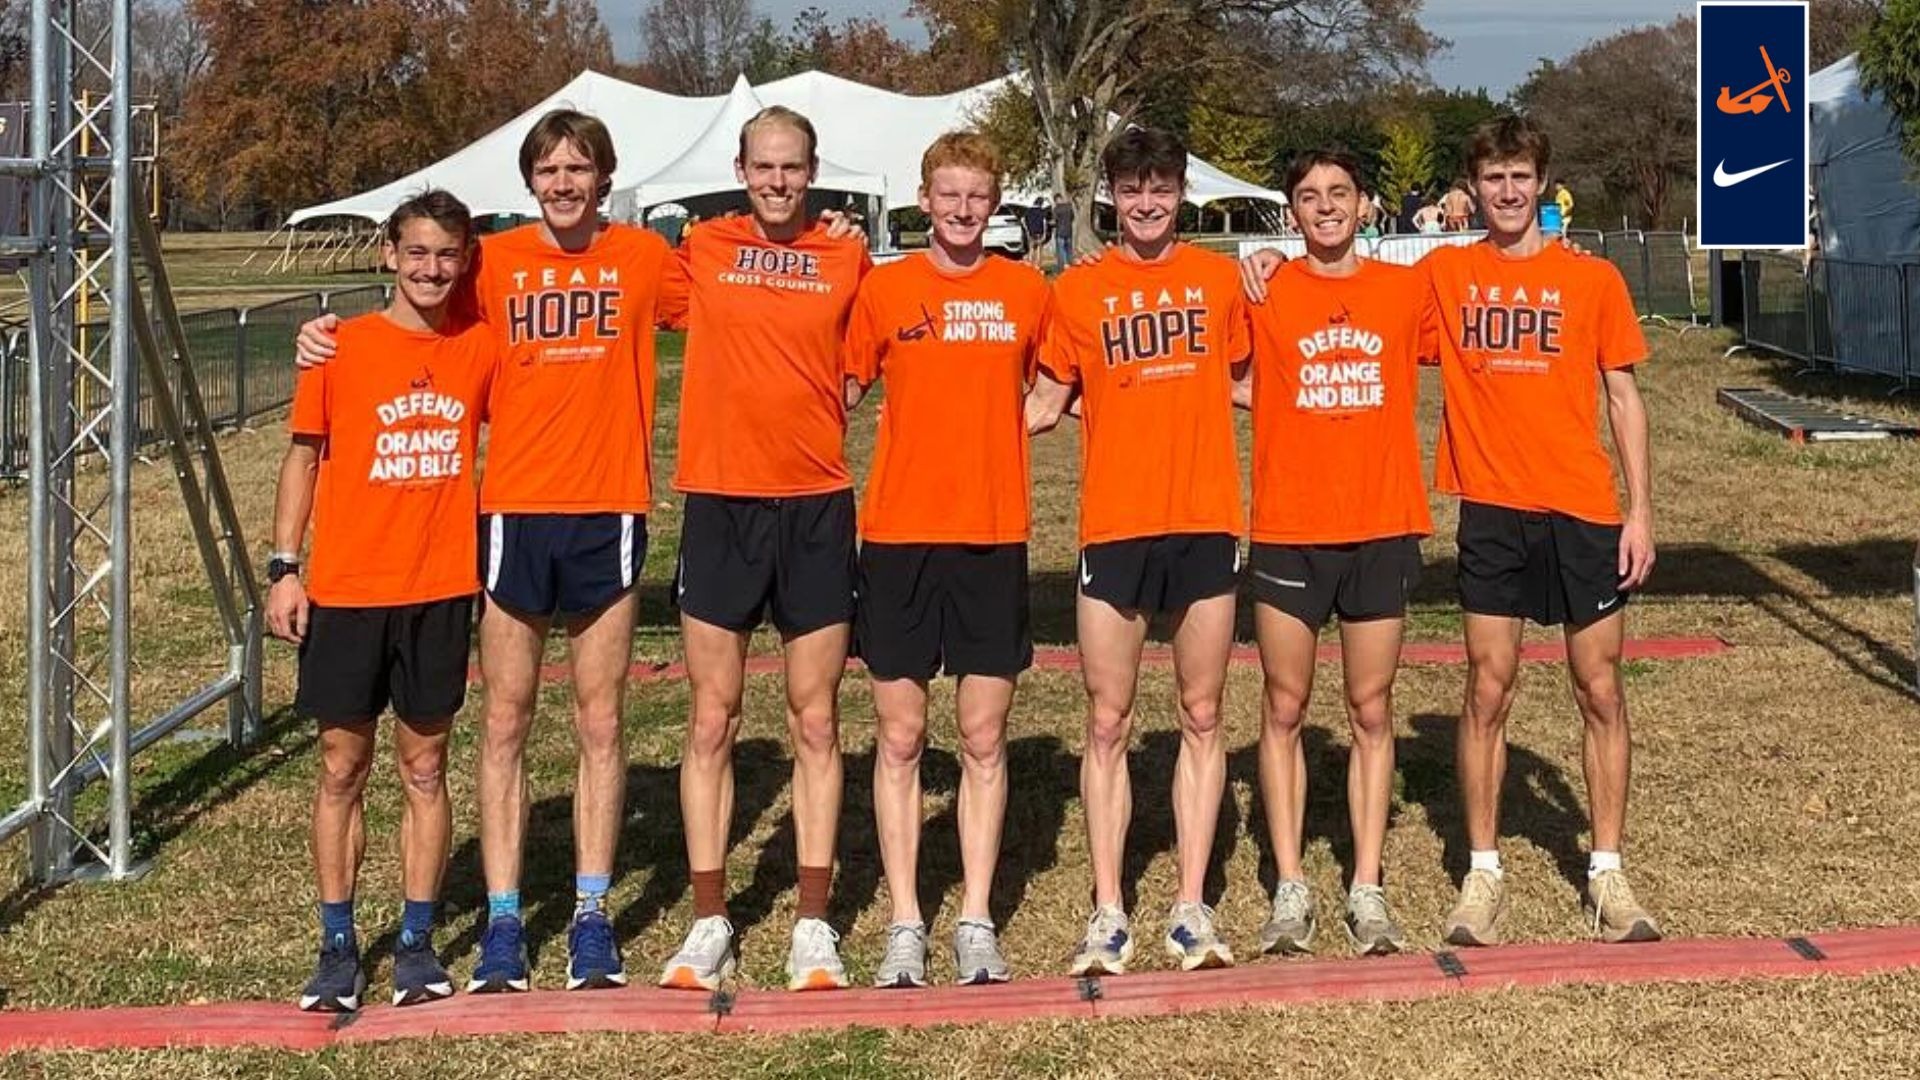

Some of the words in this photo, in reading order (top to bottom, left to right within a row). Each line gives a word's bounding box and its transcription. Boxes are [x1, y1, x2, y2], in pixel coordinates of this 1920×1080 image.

[735, 247, 820, 278] HOPE
[513, 268, 619, 290] TEAM
[718, 272, 762, 286] CROSS
[766, 277, 833, 294] COUNTRY
[1103, 286, 1204, 314] TEAM
[1468, 284, 1561, 305] TEAM
[506, 288, 624, 346] HOPE
[943, 301, 1004, 320] STRONG
[943, 321, 976, 341] AND
[979, 321, 1017, 341] TRUE
[1100, 308, 1210, 368] HOPE
[1461, 304, 1565, 357] HOPE
[1298, 328, 1383, 360] DEFEND
[1301, 361, 1382, 386] ORANGE
[1296, 386, 1339, 409] AND
[1340, 384, 1385, 407] BLUE
[377, 393, 465, 426] DEFEND
[369, 457, 416, 480] AND
